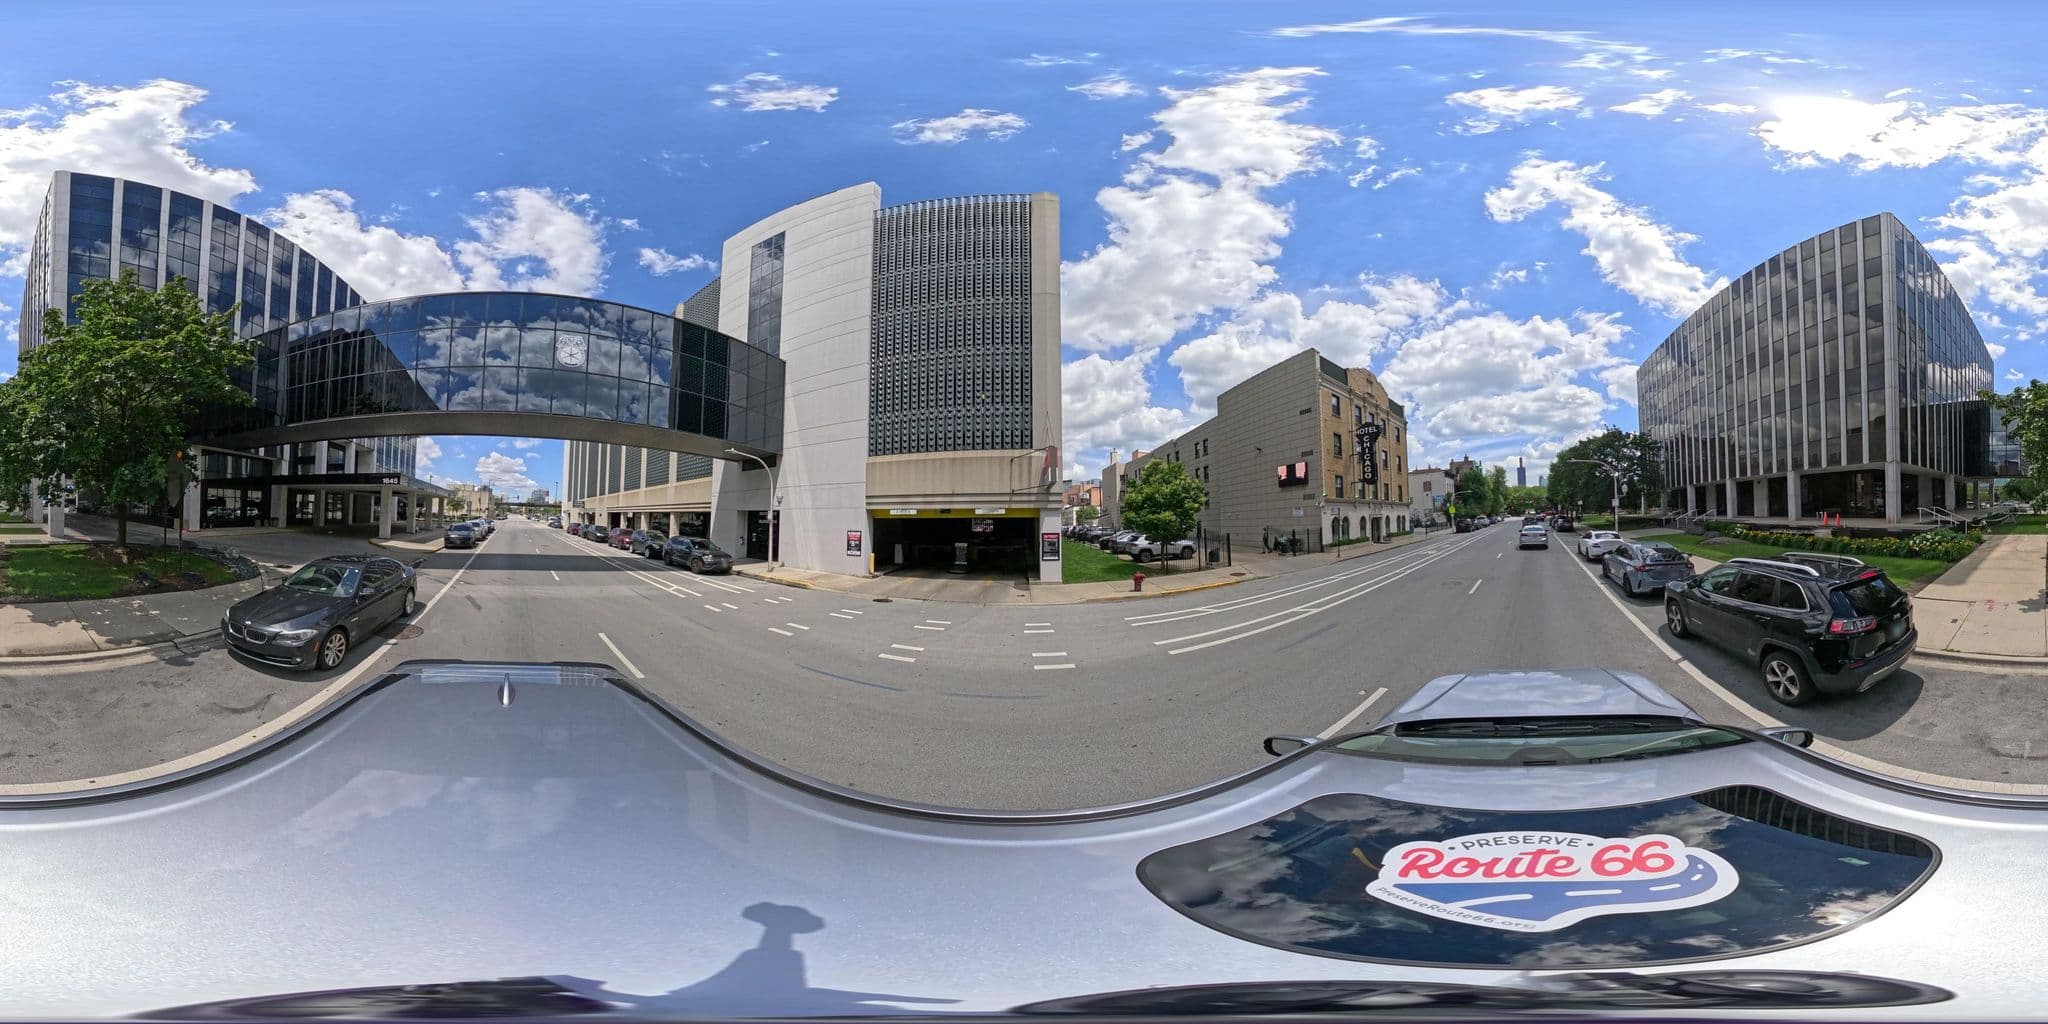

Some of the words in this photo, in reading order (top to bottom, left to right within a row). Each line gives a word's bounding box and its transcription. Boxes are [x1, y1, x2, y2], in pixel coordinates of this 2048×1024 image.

[1355, 426, 1377, 435] HOTEL
[1363, 435, 1372, 479] CHICAGO
[1399, 847, 1582, 879] Route
[1590, 840, 1675, 877] 66
[1460, 835, 1583, 851] PRESERVE
[1375, 886, 1537, 930] PreserveRoute66.org
